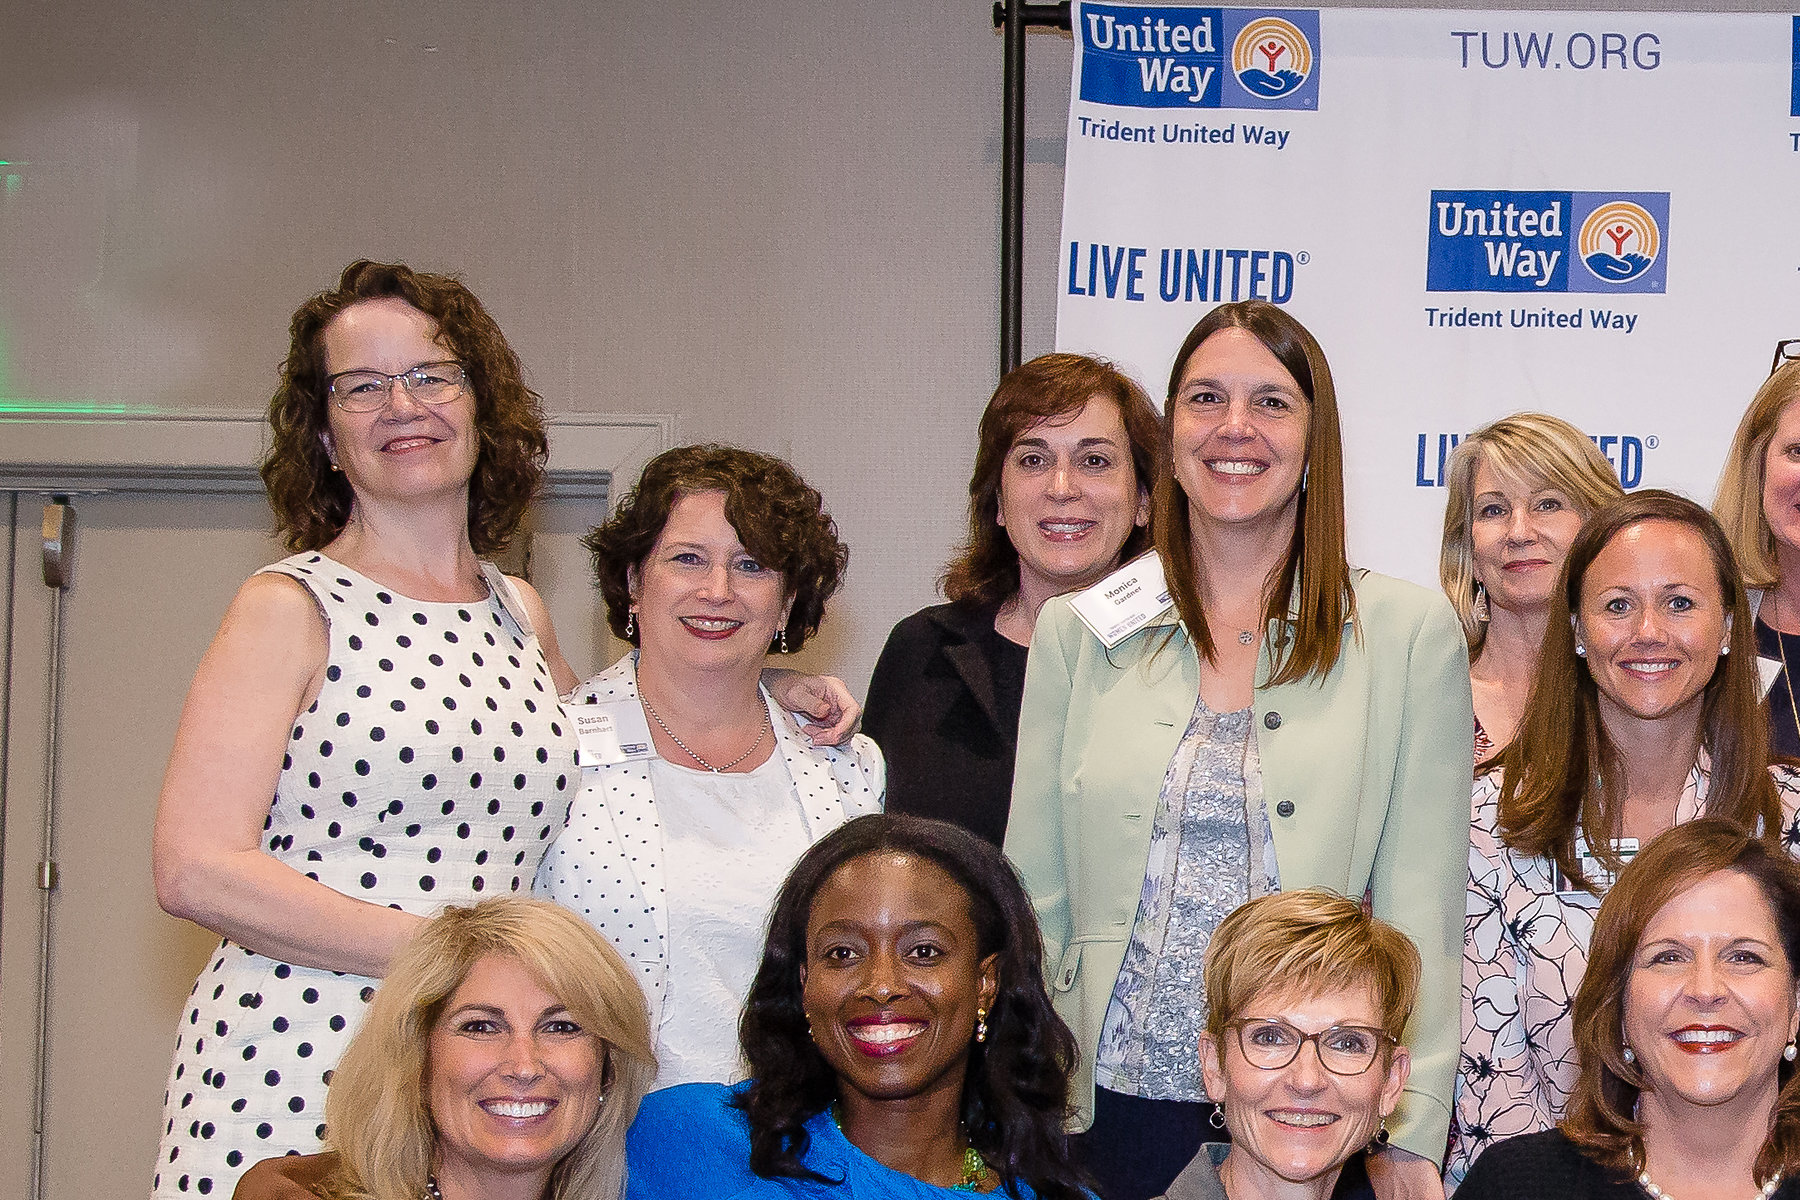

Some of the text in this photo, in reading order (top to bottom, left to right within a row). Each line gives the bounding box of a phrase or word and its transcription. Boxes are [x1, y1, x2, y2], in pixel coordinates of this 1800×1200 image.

[1086, 13, 1216, 53] United
[1450, 31, 1661, 70] TUW.ORG
[1137, 58, 1215, 103] Way
[1078, 116, 1290, 150] Trident United Way
[1437, 201, 1563, 237] United
[1068, 241, 1147, 302] LIVE
[1484, 242, 1561, 287] Way
[1425, 306, 1638, 334] Trident United Way
[1104, 576, 1138, 600] Monica
[1113, 585, 1143, 606] Gardner
[577, 716, 609, 725] Susan
